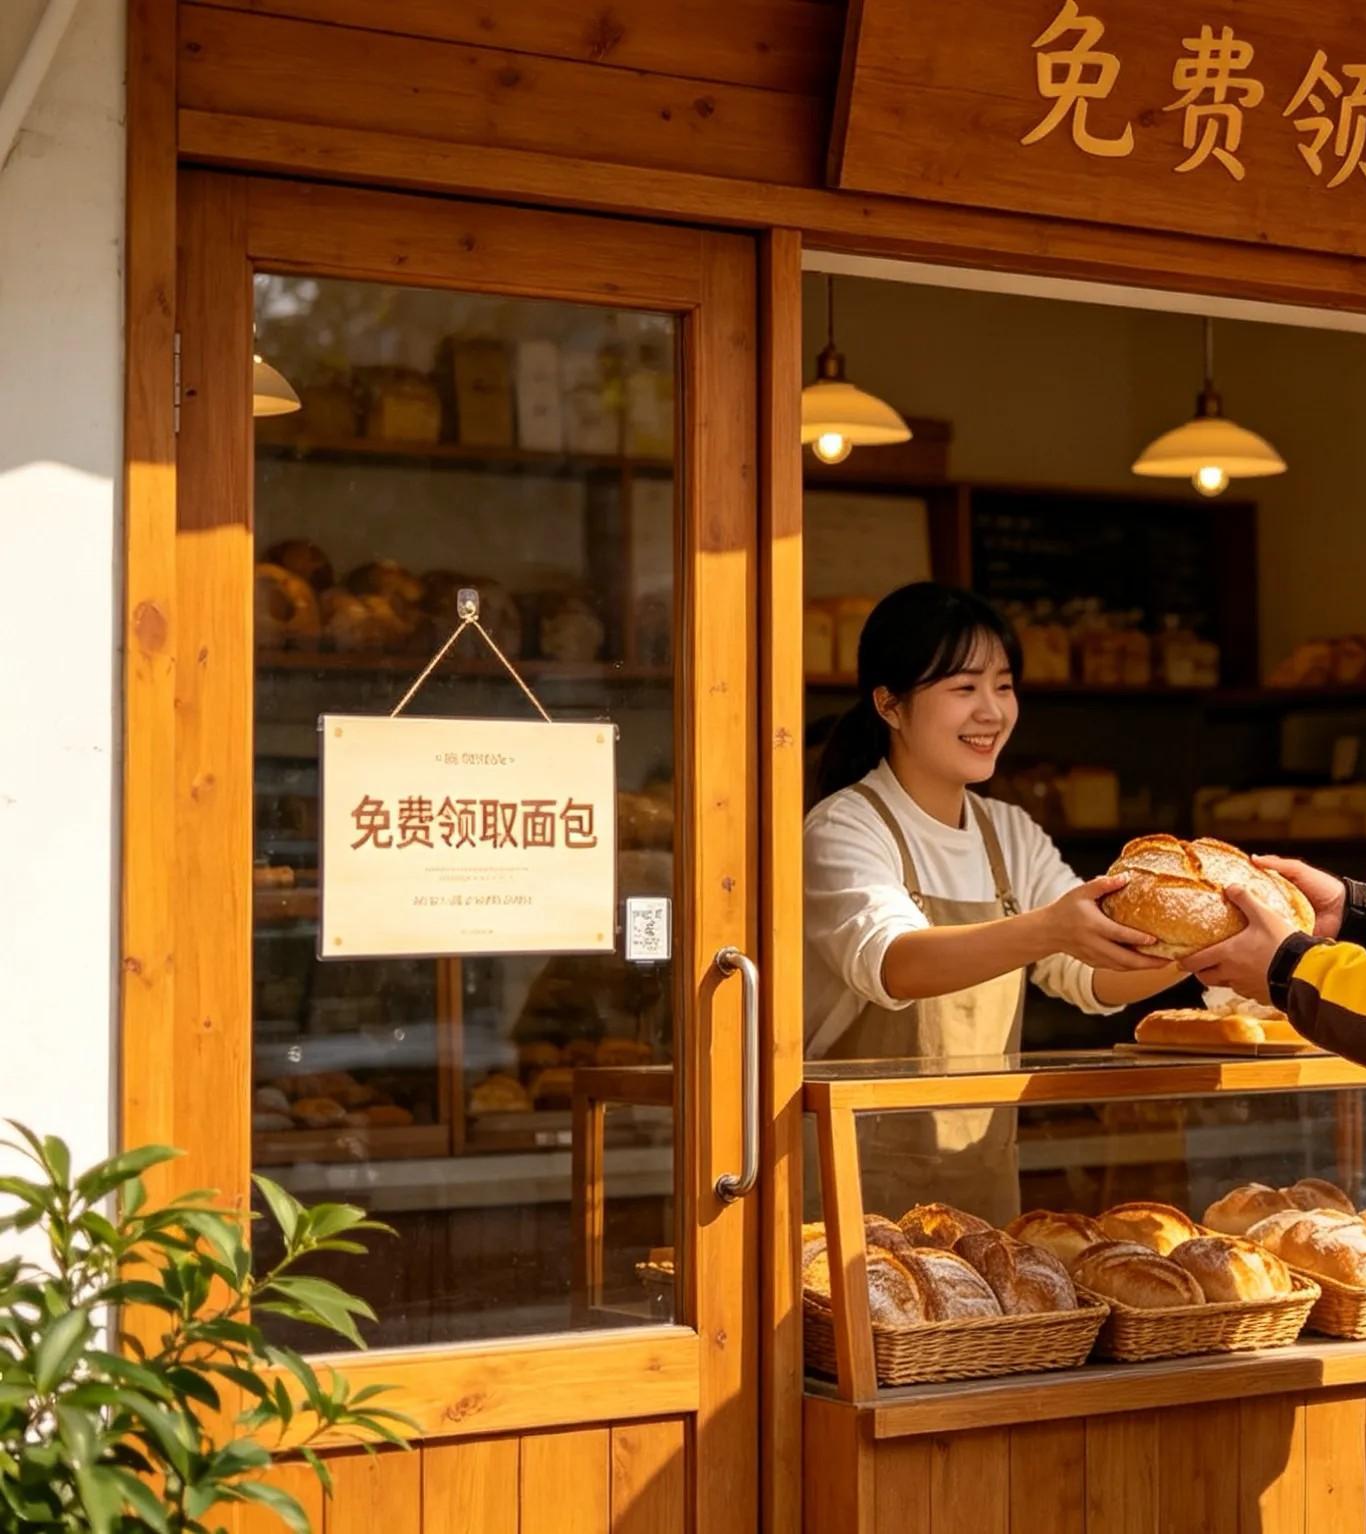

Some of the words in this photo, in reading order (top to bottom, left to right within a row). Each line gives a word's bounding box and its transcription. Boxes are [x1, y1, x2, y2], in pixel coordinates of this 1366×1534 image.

[350, 794, 598, 851] 免费领取面包
